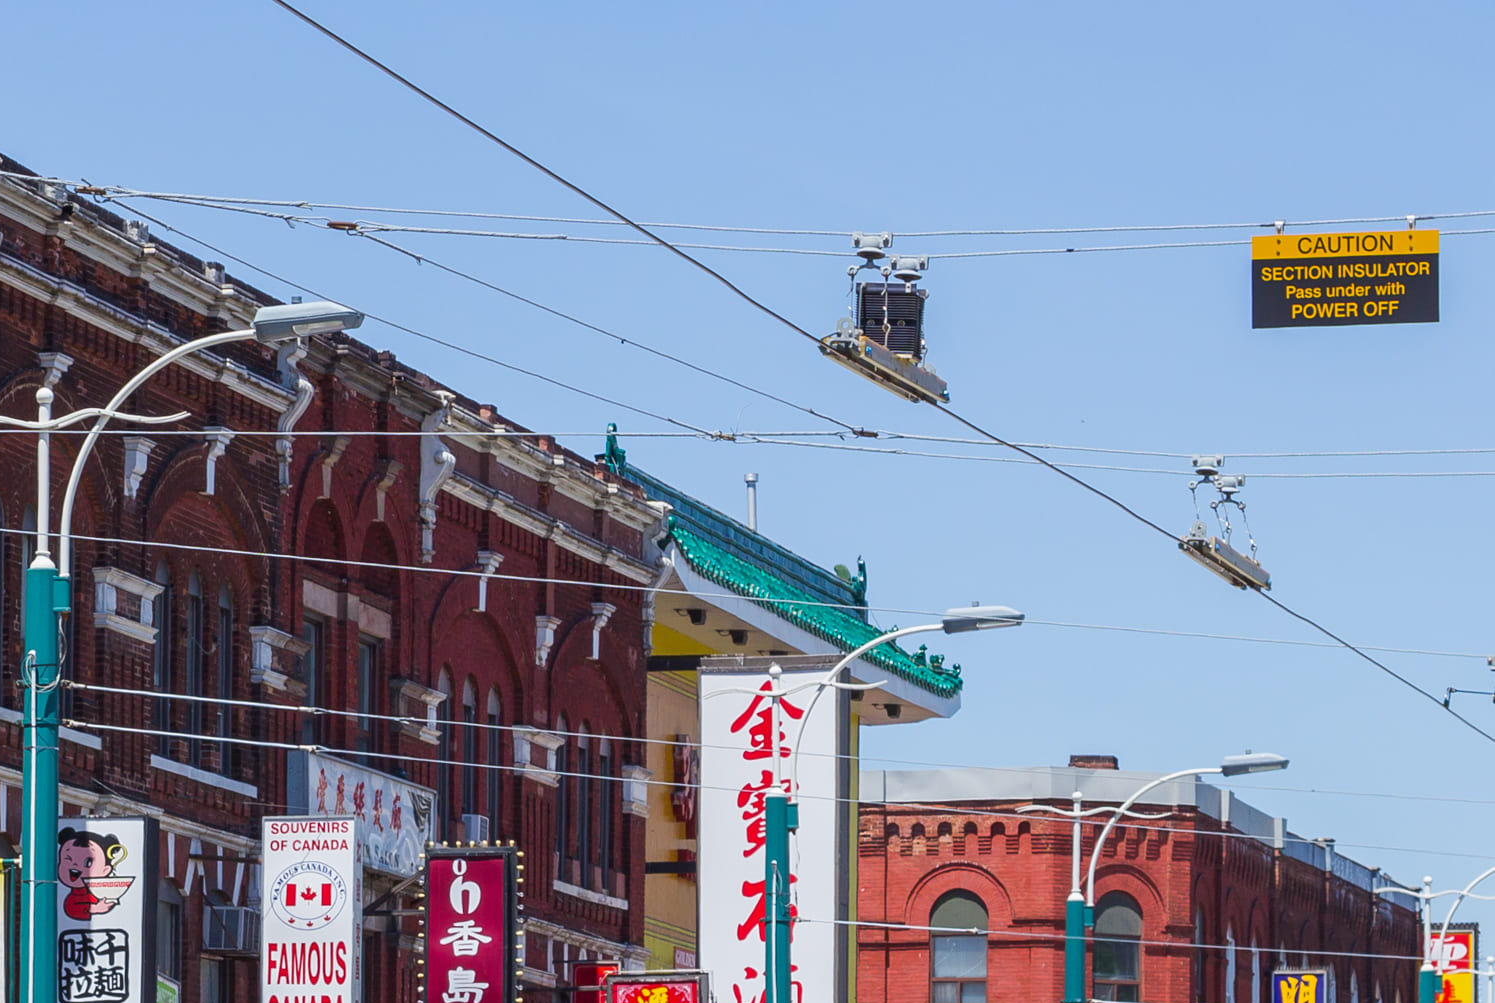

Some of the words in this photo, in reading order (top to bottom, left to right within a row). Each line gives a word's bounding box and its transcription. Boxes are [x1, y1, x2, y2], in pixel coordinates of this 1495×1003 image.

[1297, 234, 1394, 255] CAUTION
[1261, 264, 1333, 282] SECTION
[1338, 261, 1431, 279] INSULATOR
[1285, 285, 1322, 300] Pass
[1326, 283, 1371, 298] under
[1374, 281, 1406, 296] with
[1291, 302, 1359, 320] POWER
[1363, 300, 1400, 317] OFF
[270, 820, 350, 835] SOUVENIRS
[270, 840, 288, 852] OF
[291, 838, 350, 852] CANADA
[300, 862, 336, 880] CANADA
[267, 941, 348, 986] FAMOUS
